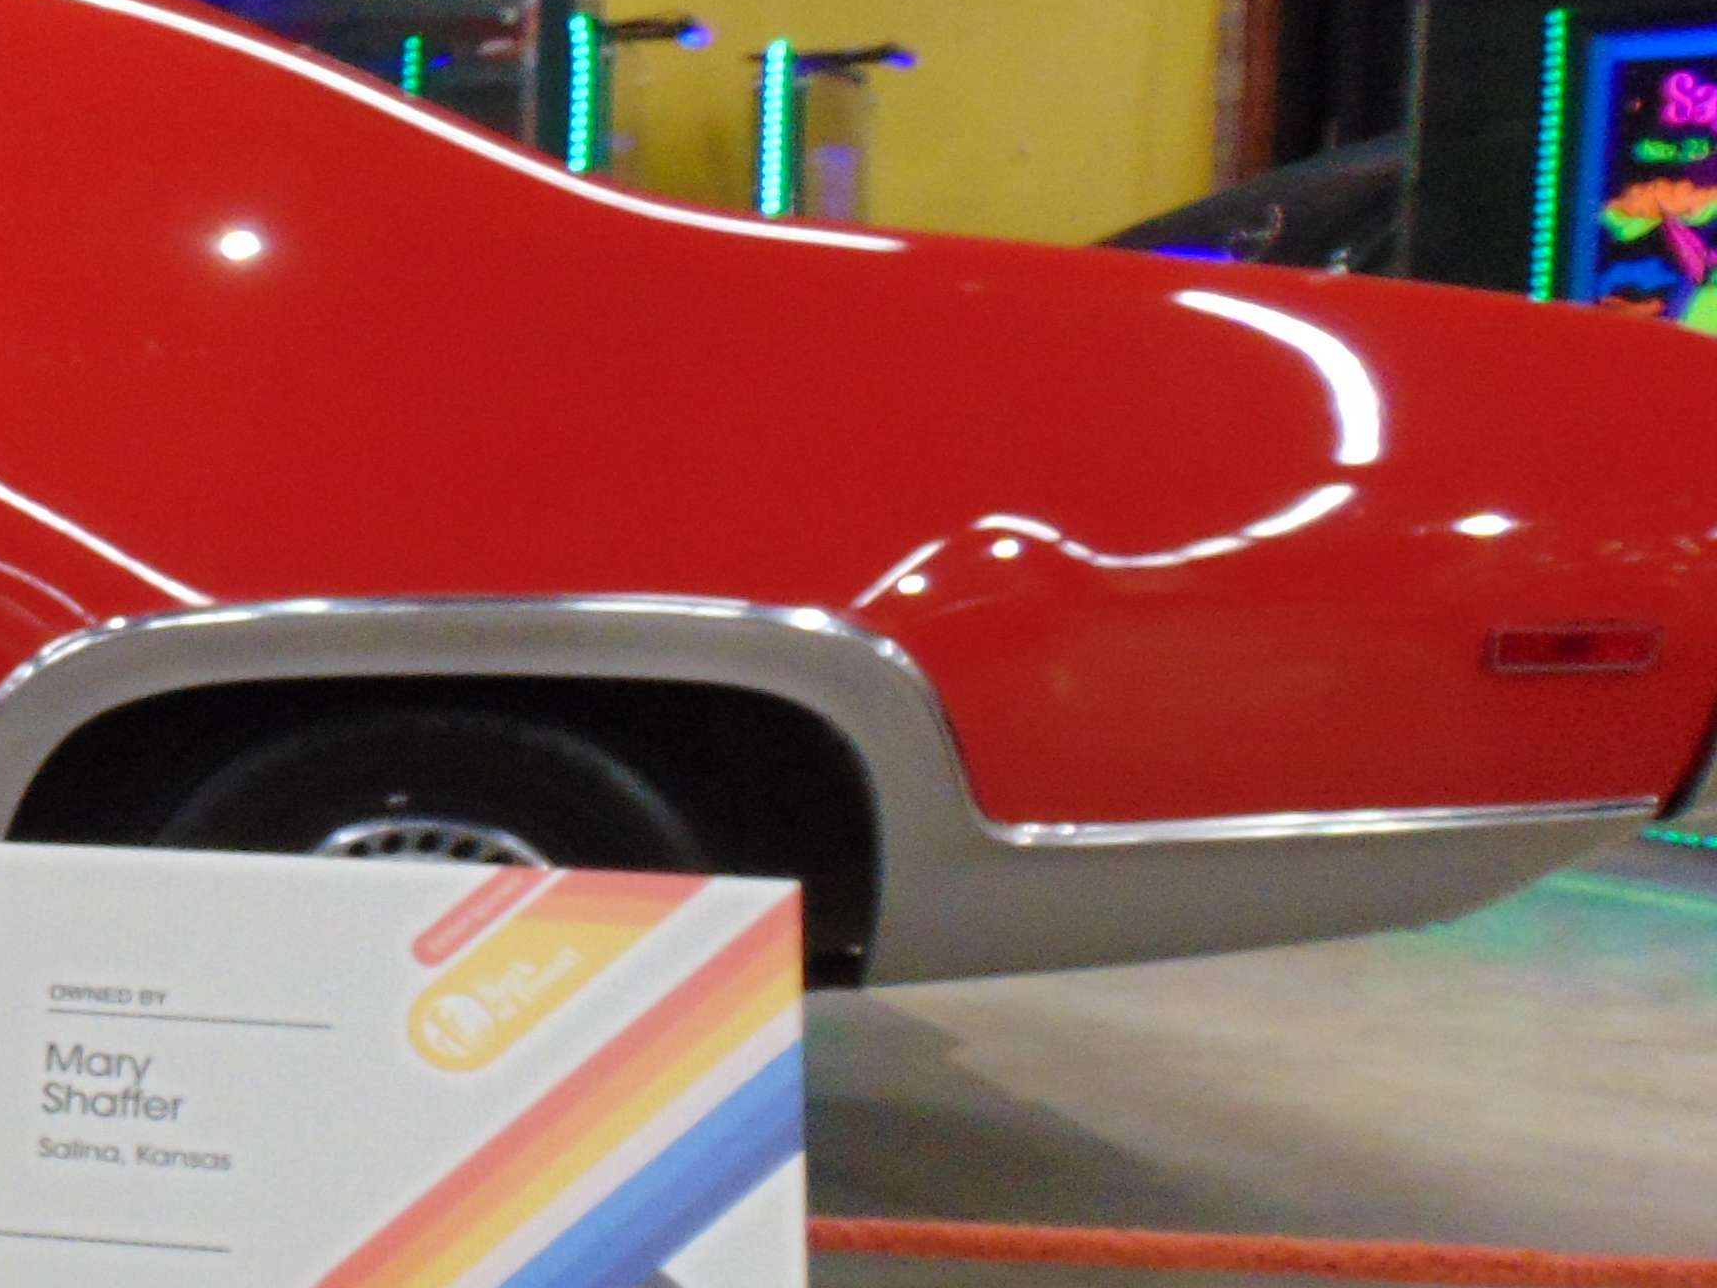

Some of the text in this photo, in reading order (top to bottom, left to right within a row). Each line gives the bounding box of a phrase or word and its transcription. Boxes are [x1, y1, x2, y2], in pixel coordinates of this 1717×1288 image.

[51, 984, 167, 1006] OWNED BY
[45, 1041, 152, 1087] Mary
[41, 1081, 185, 1121] Shaffer
[38, 1137, 233, 1171] Salina, Kansas
